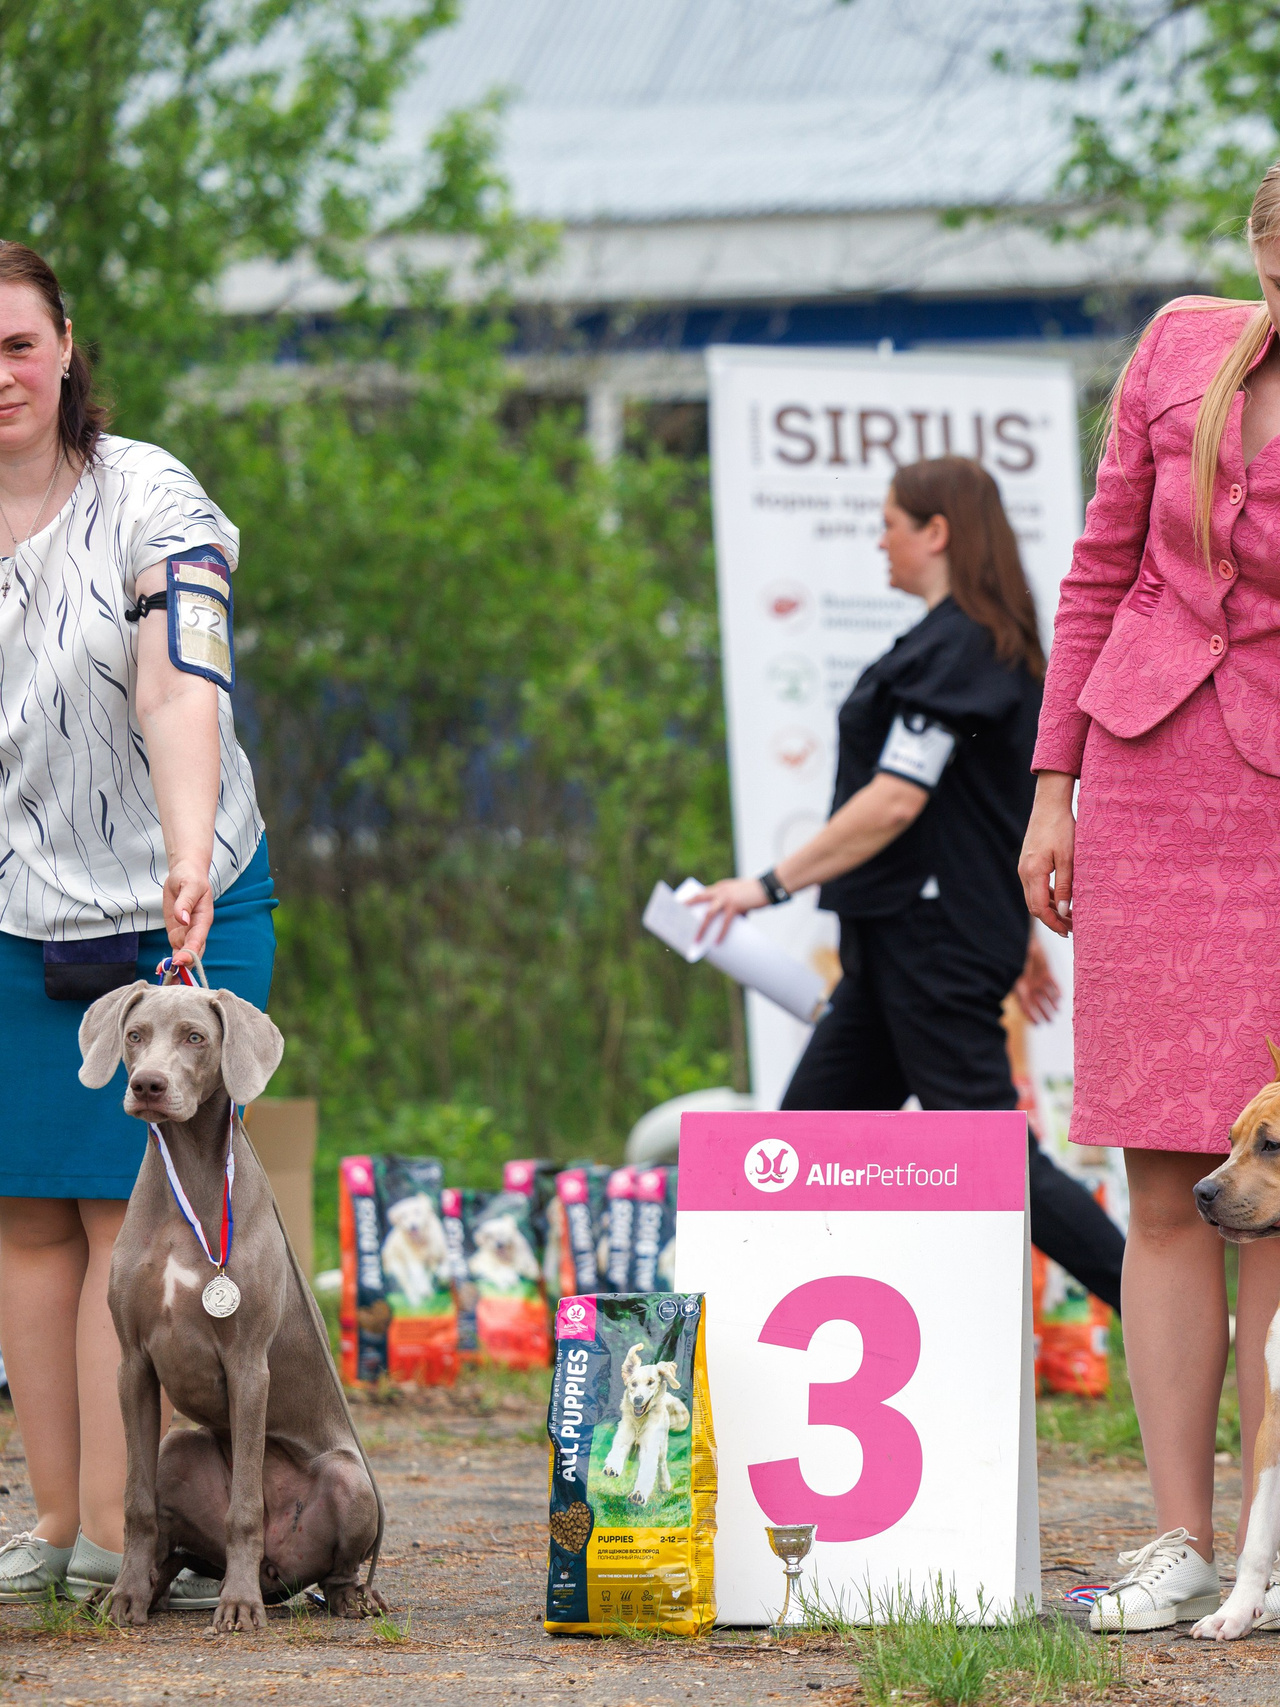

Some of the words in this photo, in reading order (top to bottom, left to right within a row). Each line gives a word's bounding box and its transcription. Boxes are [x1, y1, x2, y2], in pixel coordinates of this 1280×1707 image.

[773, 404, 1037, 473] SIRIUS
[183, 605, 221, 638] 52
[805, 1163, 958, 1186] AllerPetfood
[215, 1289, 226, 1307] 2
[561, 1349, 589, 1439] PUPPIES
[747, 1275, 923, 1543] 3
[550, 1400, 558, 1434] premium
[559, 1443, 579, 1482] ALL
[598, 1535, 634, 1543] PUPPIES
